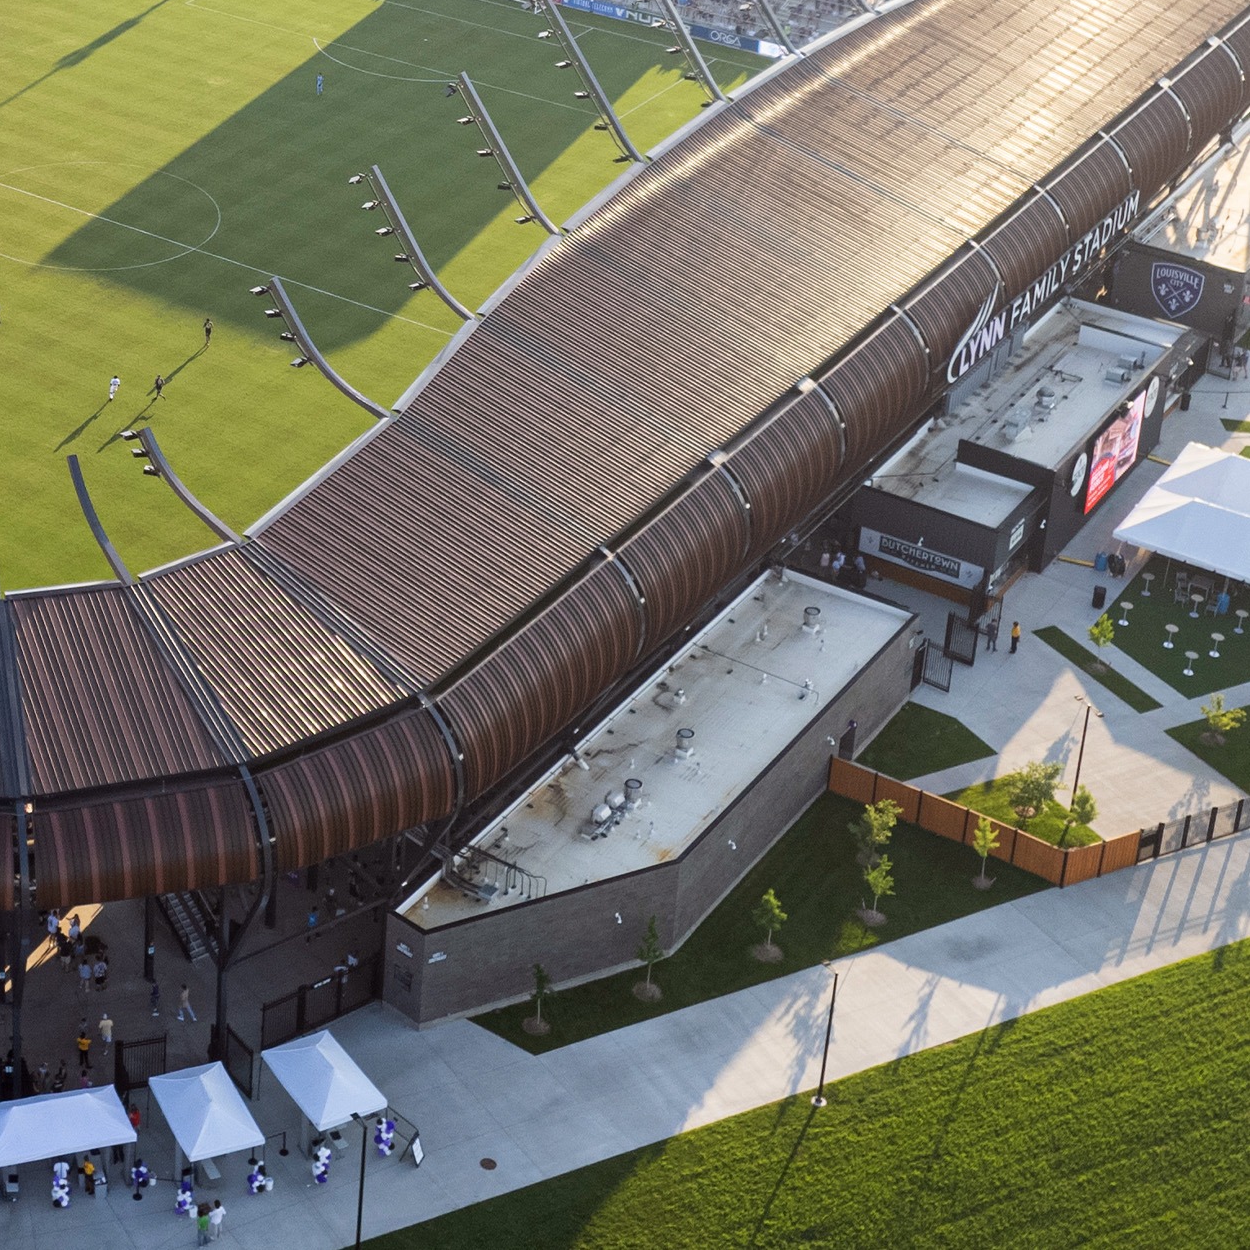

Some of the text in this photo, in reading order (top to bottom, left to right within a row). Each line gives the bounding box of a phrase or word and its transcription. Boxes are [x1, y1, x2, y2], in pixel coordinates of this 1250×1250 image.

[958, 190, 1141, 378] LYNN FAMILY STADIUM
[1156, 268, 1200, 289] LOUISVILLE
[1170, 279, 1184, 288] CITY
[881, 536, 960, 571] DUTCHERTOWN
